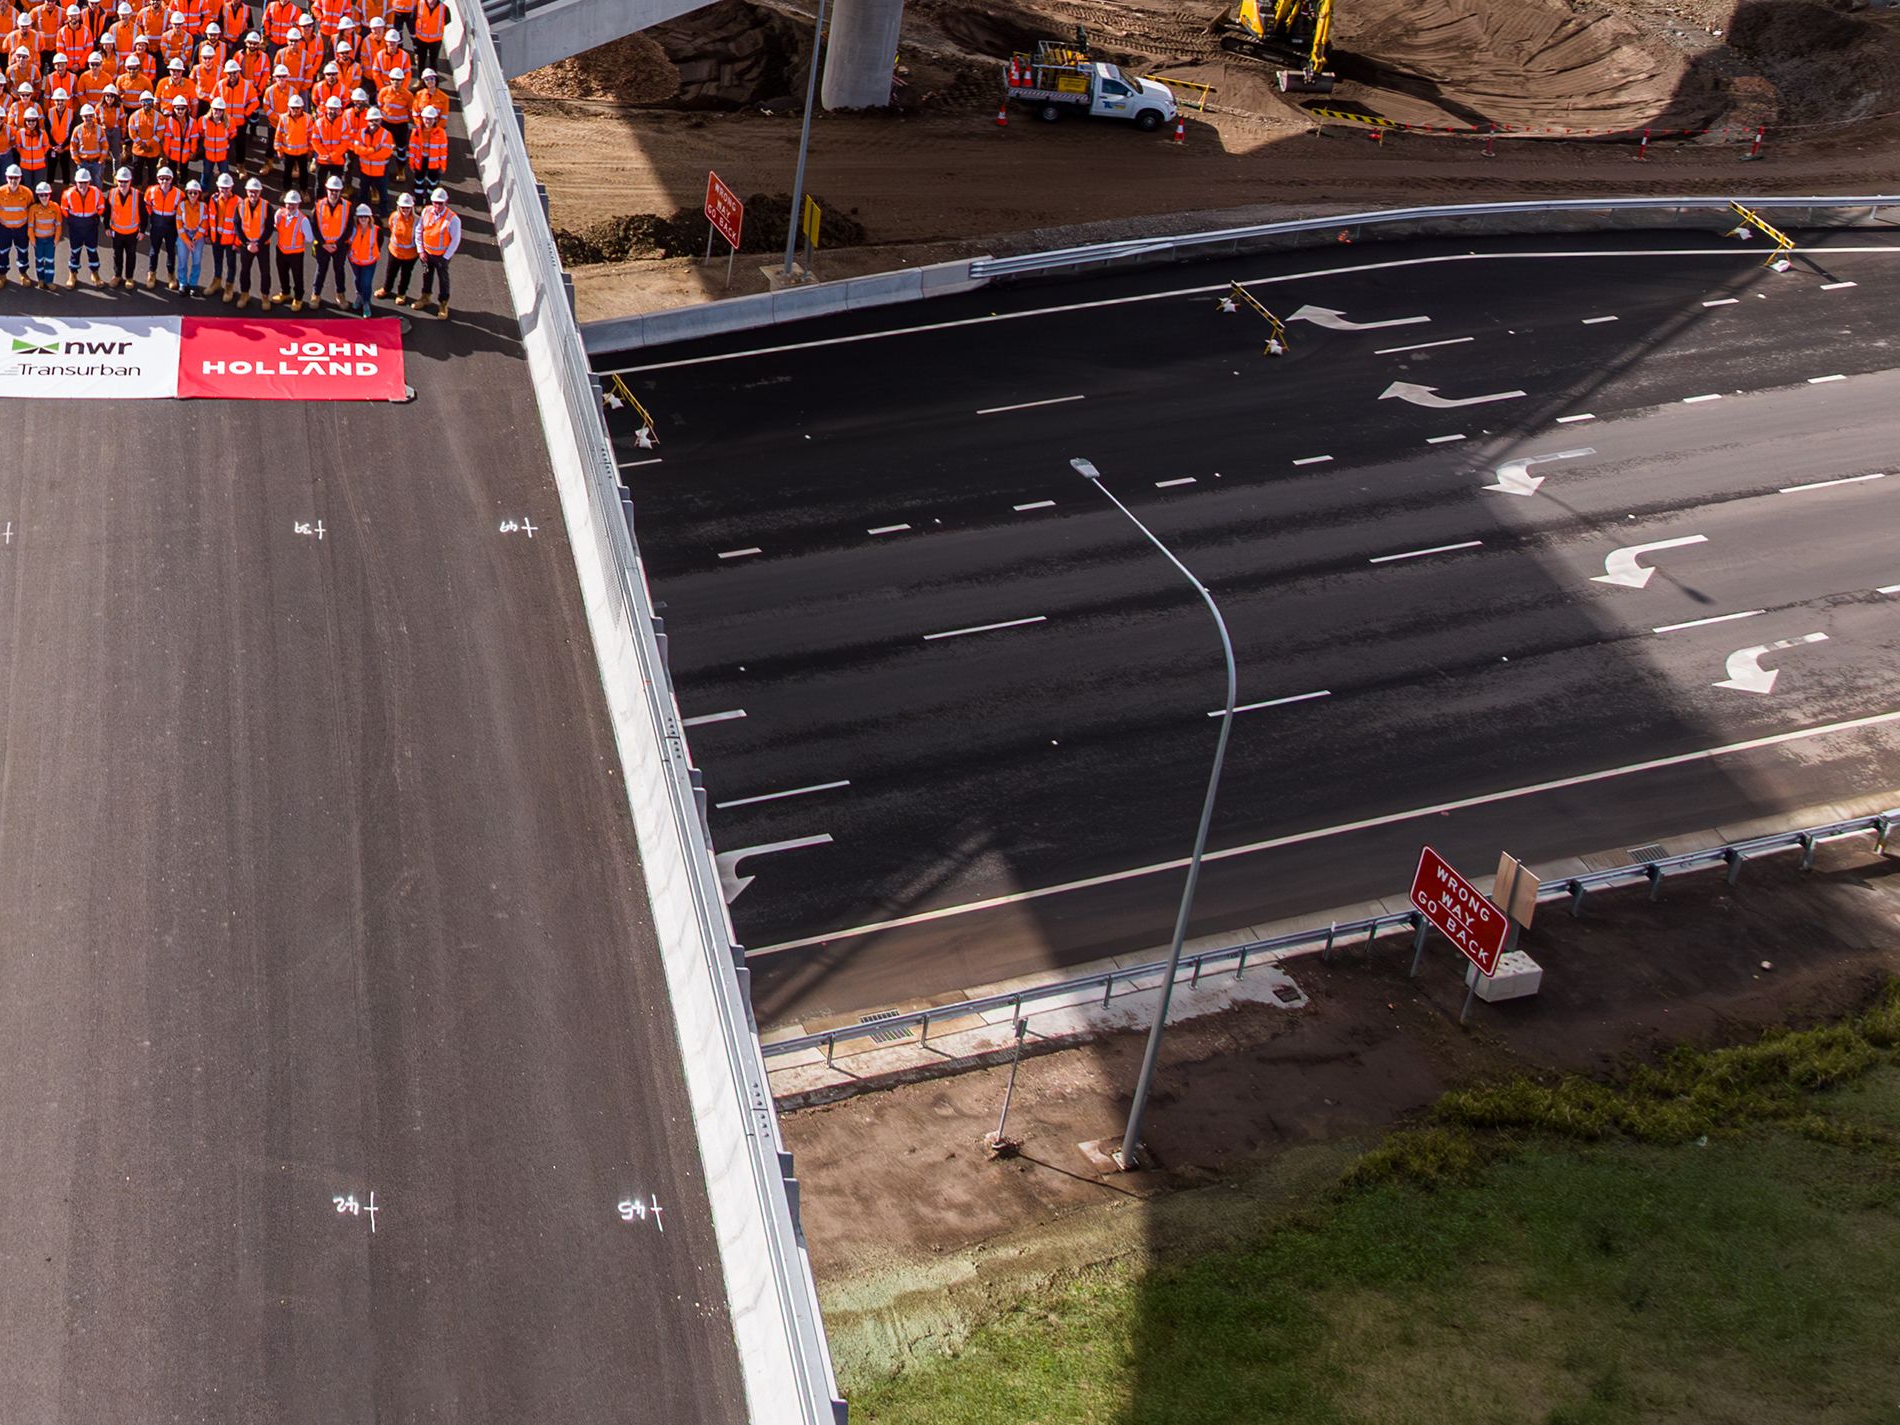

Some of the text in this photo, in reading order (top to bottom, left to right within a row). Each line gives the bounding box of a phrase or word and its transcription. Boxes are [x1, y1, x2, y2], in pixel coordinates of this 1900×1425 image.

[714, 184, 736, 212] WRONG
[717, 199, 731, 219] WAY
[707, 204, 737, 241] GO BACK
[64, 341, 133, 355] nwr
[279, 342, 378, 356] JOHN
[18, 363, 141, 377] Transurban
[202, 360, 379, 376] HOLLAND
[1436, 865, 1490, 921] WRONG
[1441, 891, 1475, 926] WAY
[1417, 890, 1489, 964] GO BACK
[333, 1195, 359, 1216] 42
